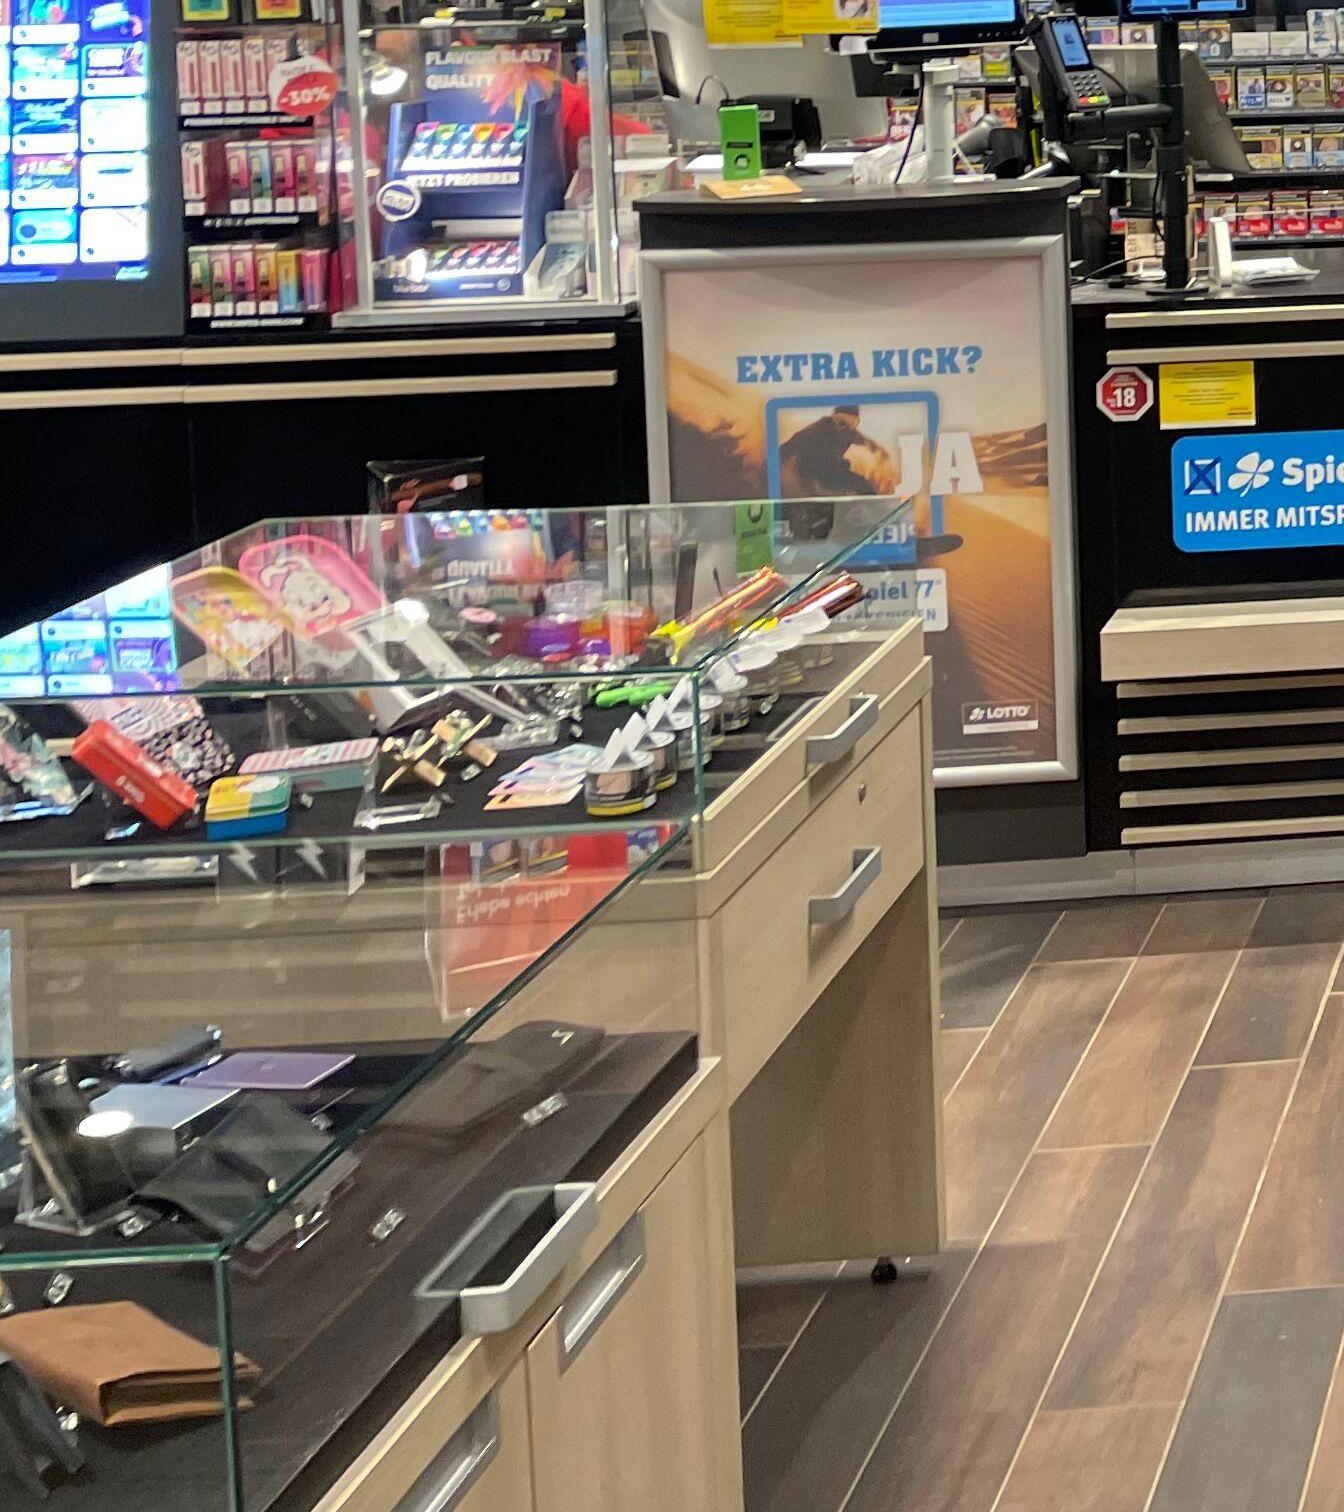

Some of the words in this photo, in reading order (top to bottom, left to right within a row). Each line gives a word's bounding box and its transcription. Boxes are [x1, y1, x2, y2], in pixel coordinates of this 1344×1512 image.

[500, 47, 553, 64] BLAST
[425, 72, 494, 91] QUALITY
[736, 351, 861, 384] EXTRA
[872, 344, 985, 378] KICK?
[893, 430, 985, 498] JA
[1185, 507, 1271, 533] IMMER
[865, 579, 909, 606] piel
[985, 701, 1031, 720] LOTTO
